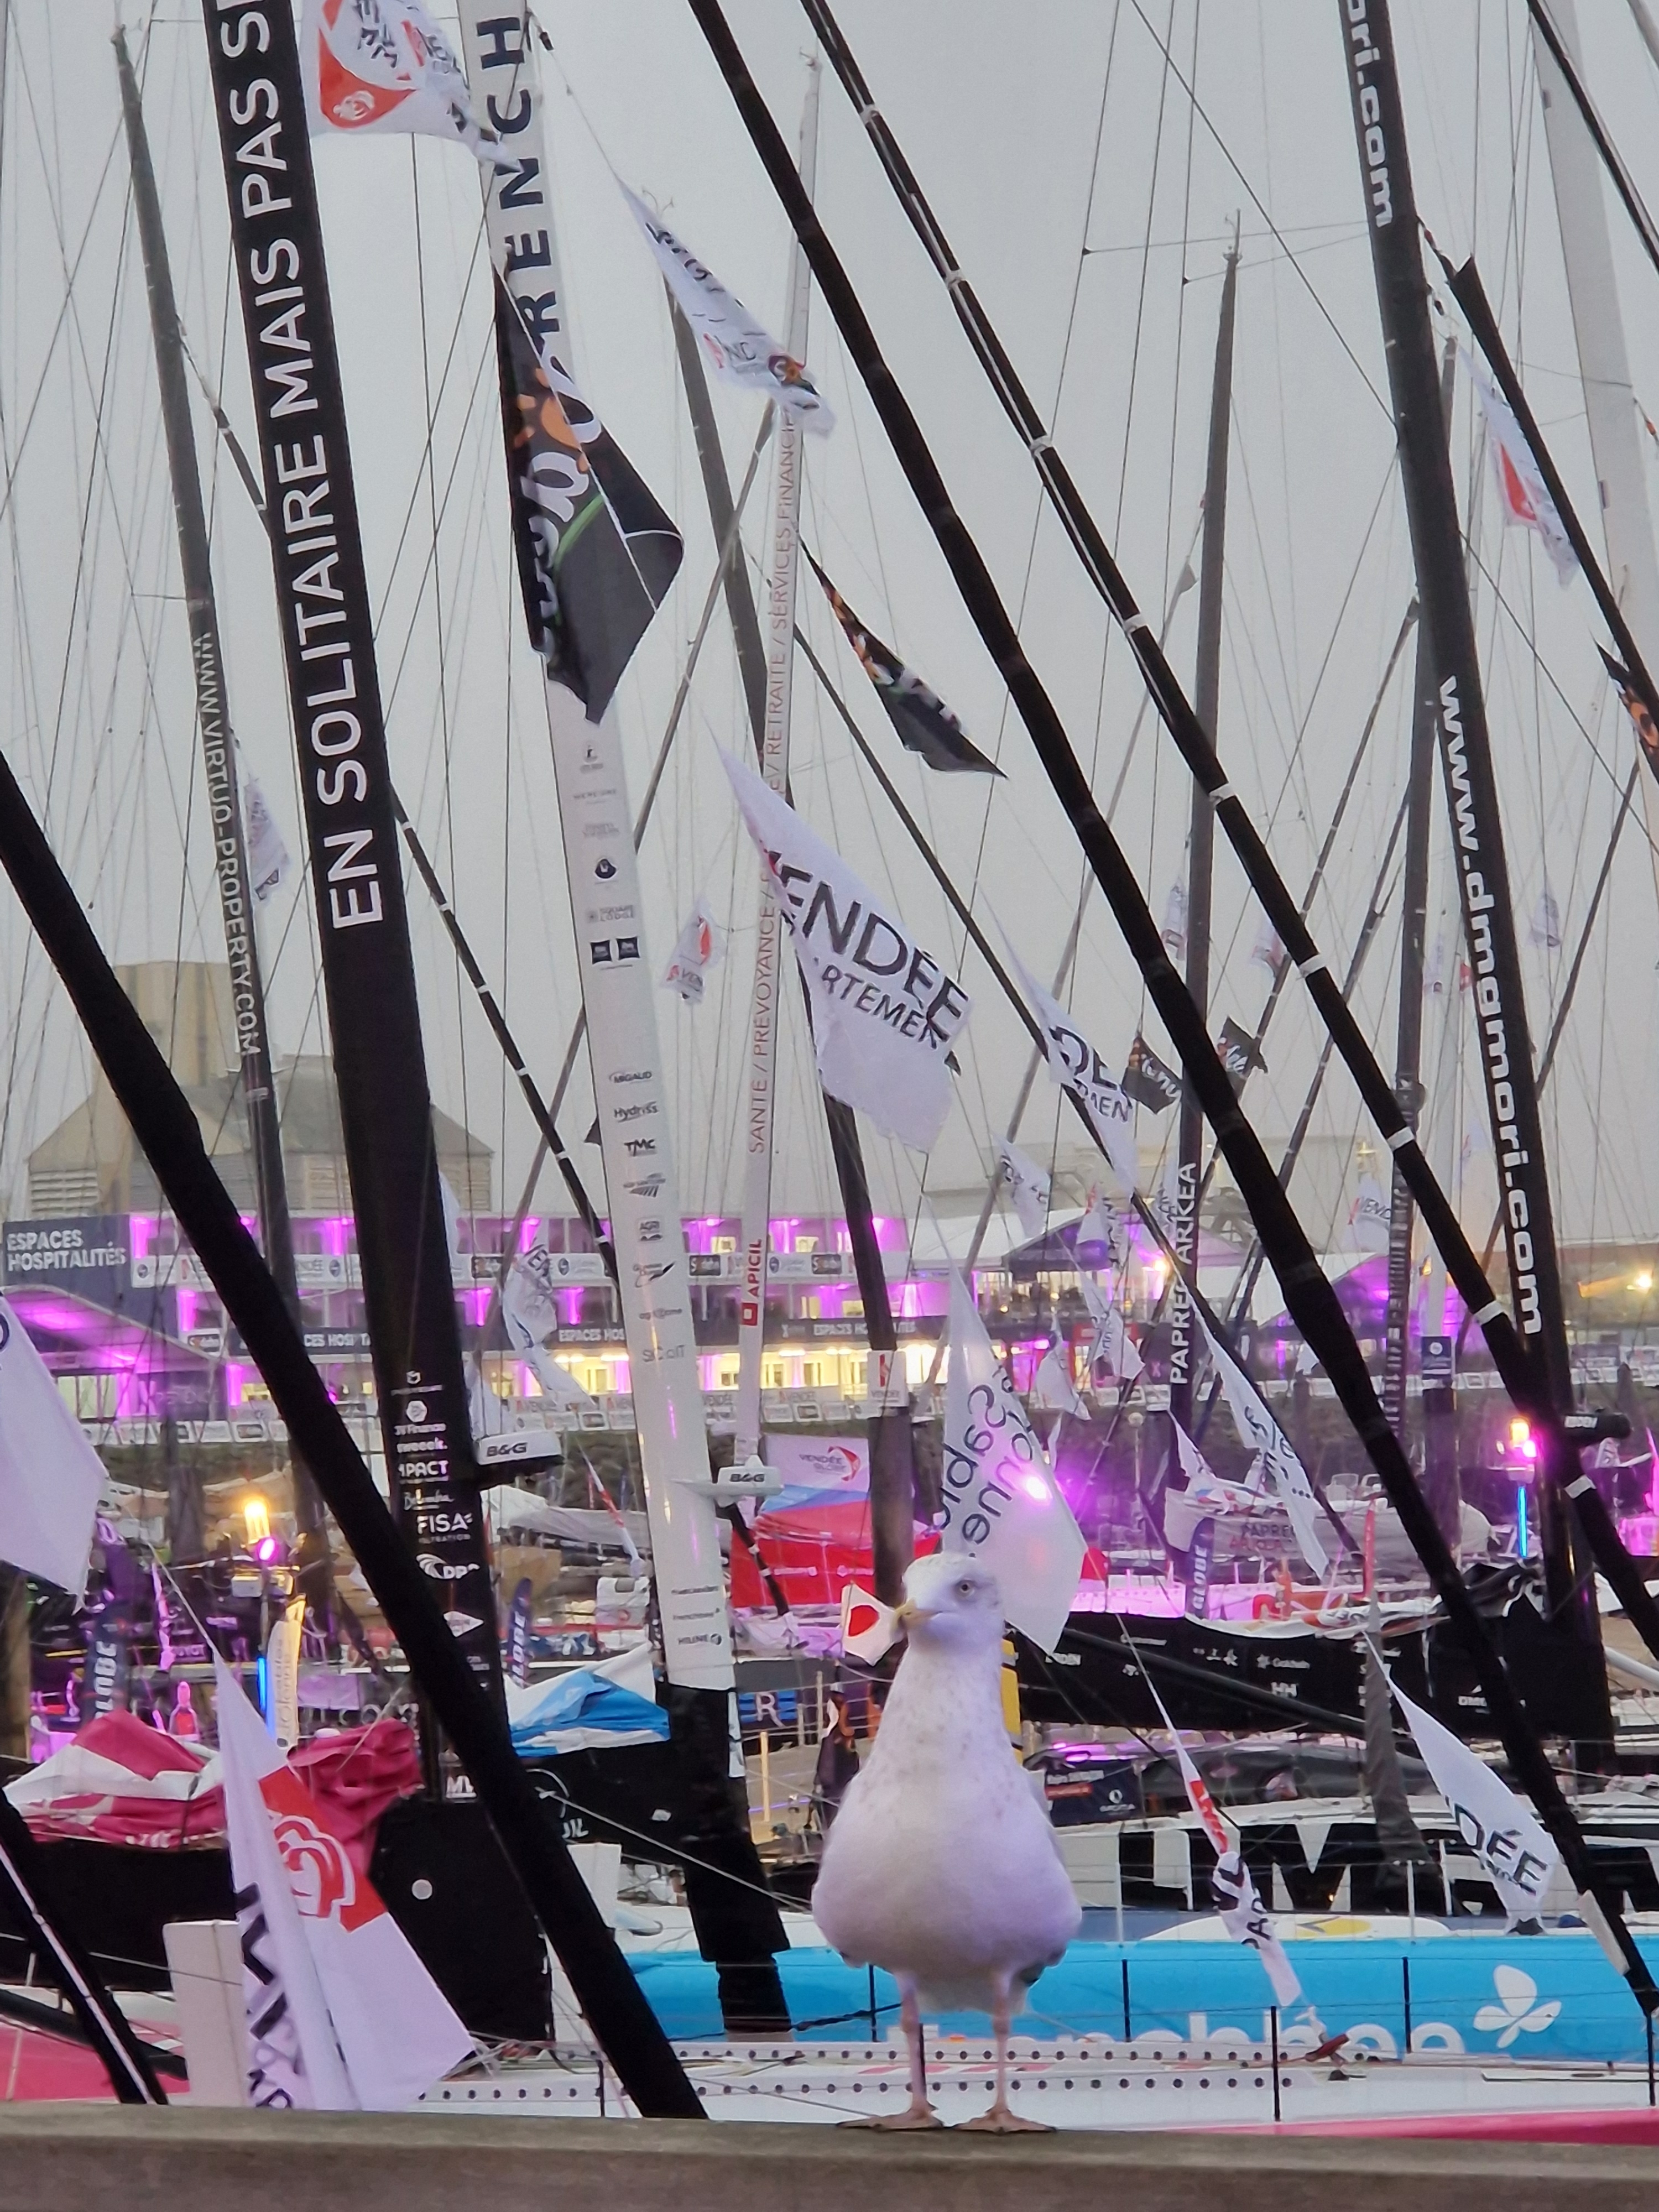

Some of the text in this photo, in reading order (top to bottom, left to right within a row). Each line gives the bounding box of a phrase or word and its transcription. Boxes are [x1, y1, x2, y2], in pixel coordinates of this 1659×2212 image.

[229, 78, 293, 219] PAS
[476, 17, 561, 357] RENCH
[251, 238, 319, 419] MAIS
[275, 434, 367, 806] SOLITAIRE
[324, 829, 383, 930] EN
[1439, 675, 1542, 1335] www.dmgmori.com
[7, 1229, 82, 1251] ESPACES
[8, 1241, 127, 1271] HOSPITALITÉS
[747, 1238, 763, 1298] APICIL
[486, 1442, 527, 1455] B&G
[729, 1472, 765, 1483] B&G
